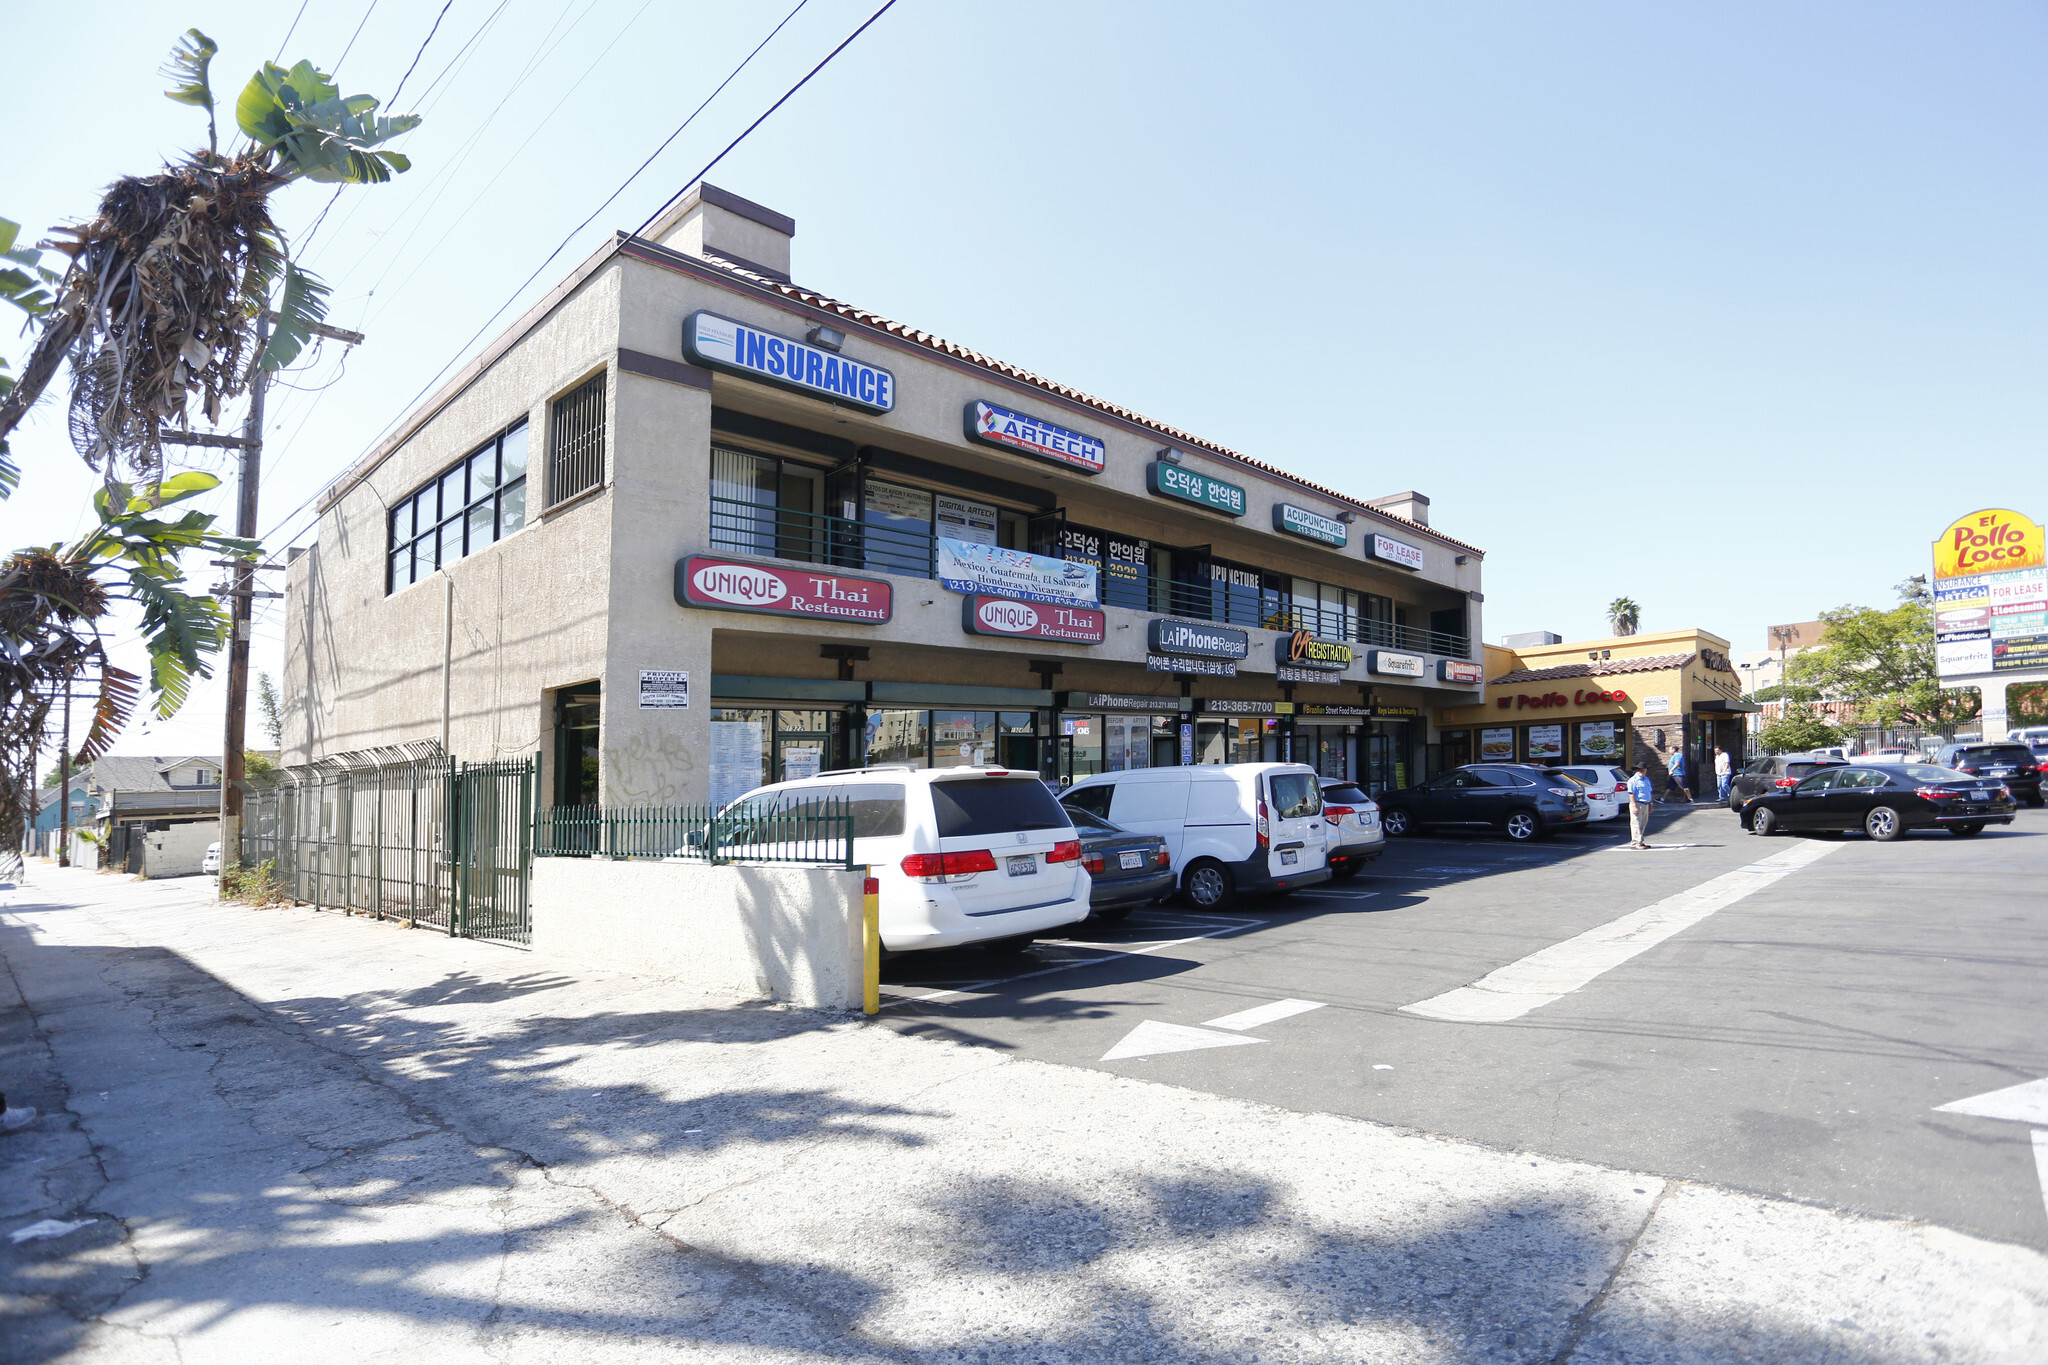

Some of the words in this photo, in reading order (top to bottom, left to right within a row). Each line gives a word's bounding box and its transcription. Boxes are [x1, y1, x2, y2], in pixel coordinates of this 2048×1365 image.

[735, 327, 888, 407] INSURANCE
[1008, 412, 1096, 446] DIGITAL
[1003, 420, 1096, 461] ARTECH
[1001, 435, 1018, 445] Design
[1021, 441, 1040, 452] Printing
[1042, 448, 1067, 461] Advertising
[1069, 456, 1082, 465] Photo
[1086, 461, 1098, 469] Video
[1164, 468, 1203, 498] 오덕상
[1208, 482, 1241, 510] 한의원
[938, 500, 966, 513] DIGITAL
[966, 506, 995, 518] ARTECH
[1286, 507, 1343, 535] ACUPUNCTURE
[1978, 514, 1997, 527] El
[1953, 523, 2025, 551] Pollo
[987, 548, 1033, 569] USA
[1109, 540, 1145, 566] 한의원
[1377, 538, 1395, 553] FOR
[1396, 545, 1421, 562] LEASE
[1957, 545, 2027, 568] Loco
[953, 557, 988, 574] Mexico,
[990, 565, 1041, 583] Guatemala,
[1043, 575, 1052, 585] El
[1052, 577, 1091, 591] Salvador,
[1936, 575, 1982, 591] INSURANCE
[1990, 571, 2024, 583] INCOME
[2028, 568, 2045, 577] TAX
[703, 570, 779, 601] UNIQUE
[809, 577, 869, 603] Thai
[950, 580, 977, 593] (213)
[977, 573, 1023, 590] Honduras
[1024, 584, 1030, 593] y
[1031, 584, 1075, 598] Nicaragua
[1935, 589, 1988, 603] ARTECH
[1993, 587, 2011, 598] FOR
[2014, 583, 2044, 596] LEASE
[790, 595, 885, 619] Restaurant
[985, 605, 1033, 628] UNIQUE
[1998, 601, 2046, 615] Locksmith
[1054, 609, 1093, 629] Thai
[1040, 623, 1101, 641] Restaurant
[1148, 655, 1170, 671] 아이폰
[1308, 641, 1352, 663] REGISTRATION
[1940, 652, 1988, 664] Squarefritz
[1388, 658, 1415, 671] Squarefritz
[1211, 700, 1273, 712] 213-365-7700
[1306, 705, 1325, 714] Brazilian
[1325, 705, 1339, 715] Street
[1338, 706, 1350, 715] Food
[1350, 706, 1371, 716] Restaurant
[1497, 696, 1513, 708] El
[1517, 691, 1568, 710] Pollo
[1574, 689, 1627, 705] Loco
[1378, 707, 1387, 716] Keys
[1387, 707, 1398, 715] Locks
[1402, 708, 1417, 716] Security
